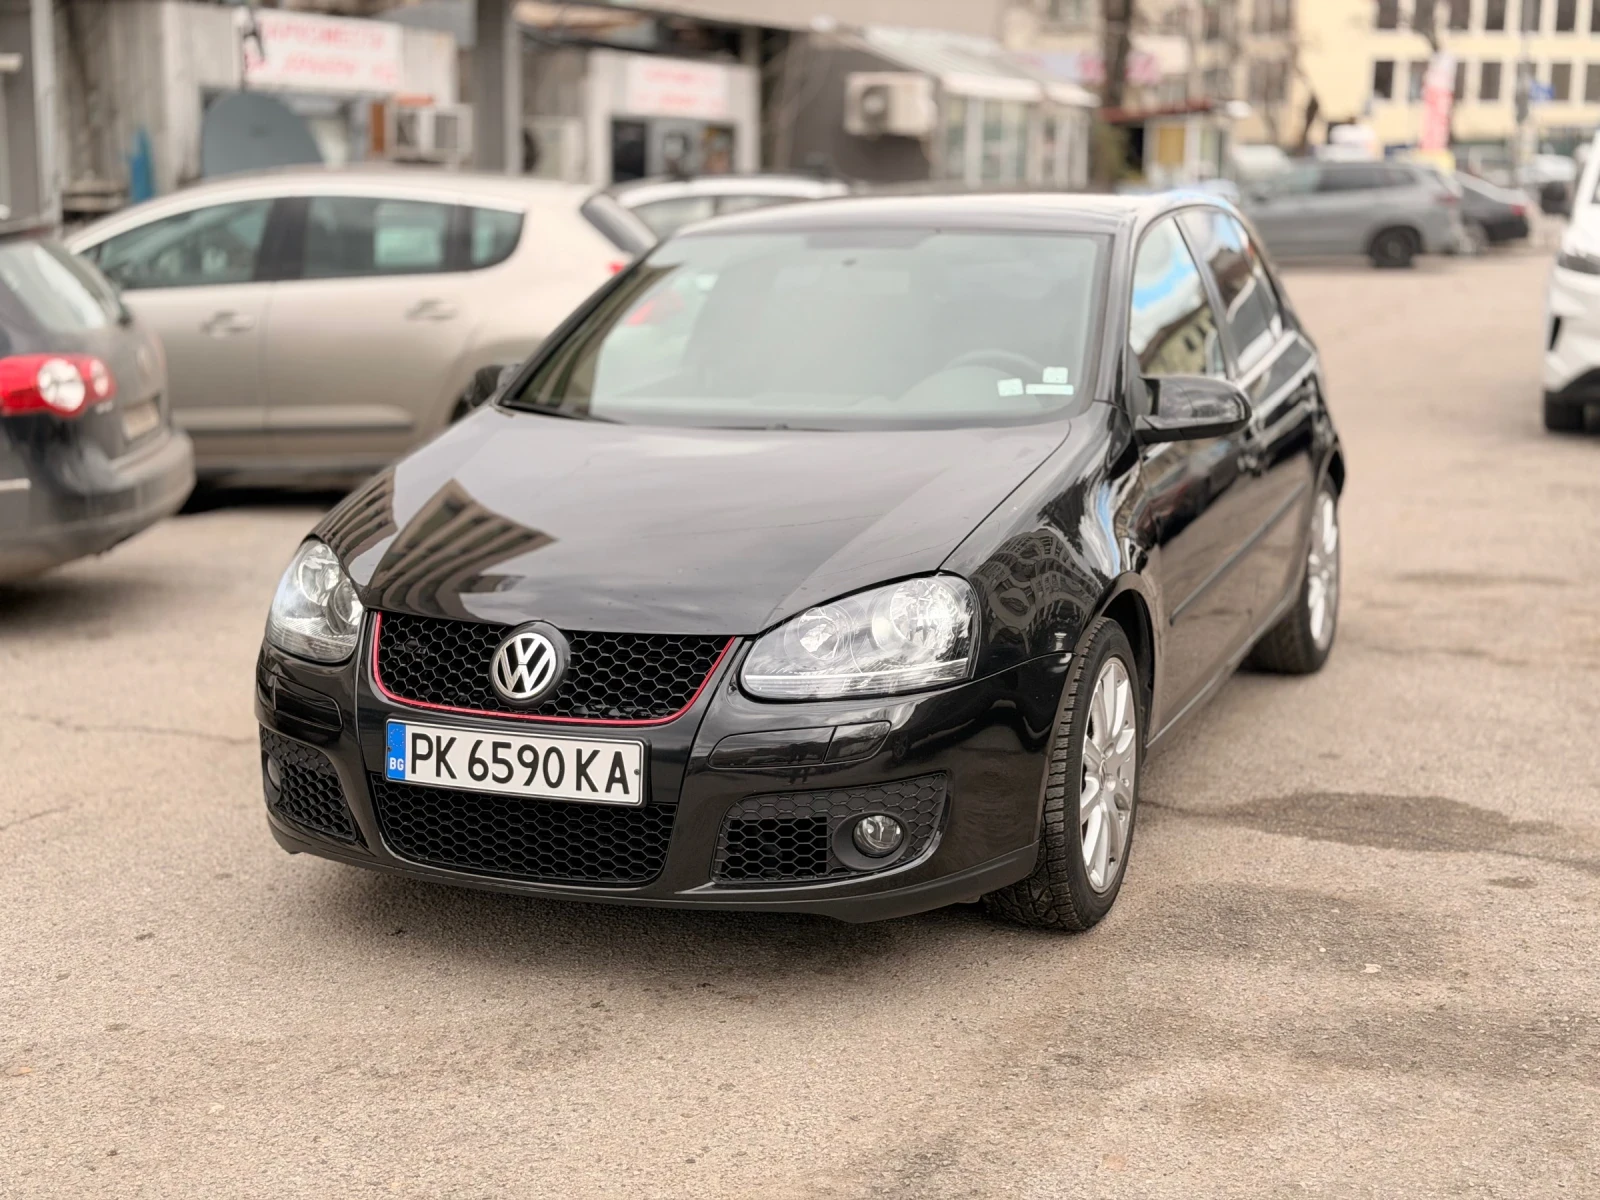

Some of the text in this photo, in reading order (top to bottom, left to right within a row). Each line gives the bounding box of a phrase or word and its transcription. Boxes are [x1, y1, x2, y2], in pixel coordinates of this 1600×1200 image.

[389, 757, 404, 771] BG
[411, 733, 630, 794] PK 6590 KA
